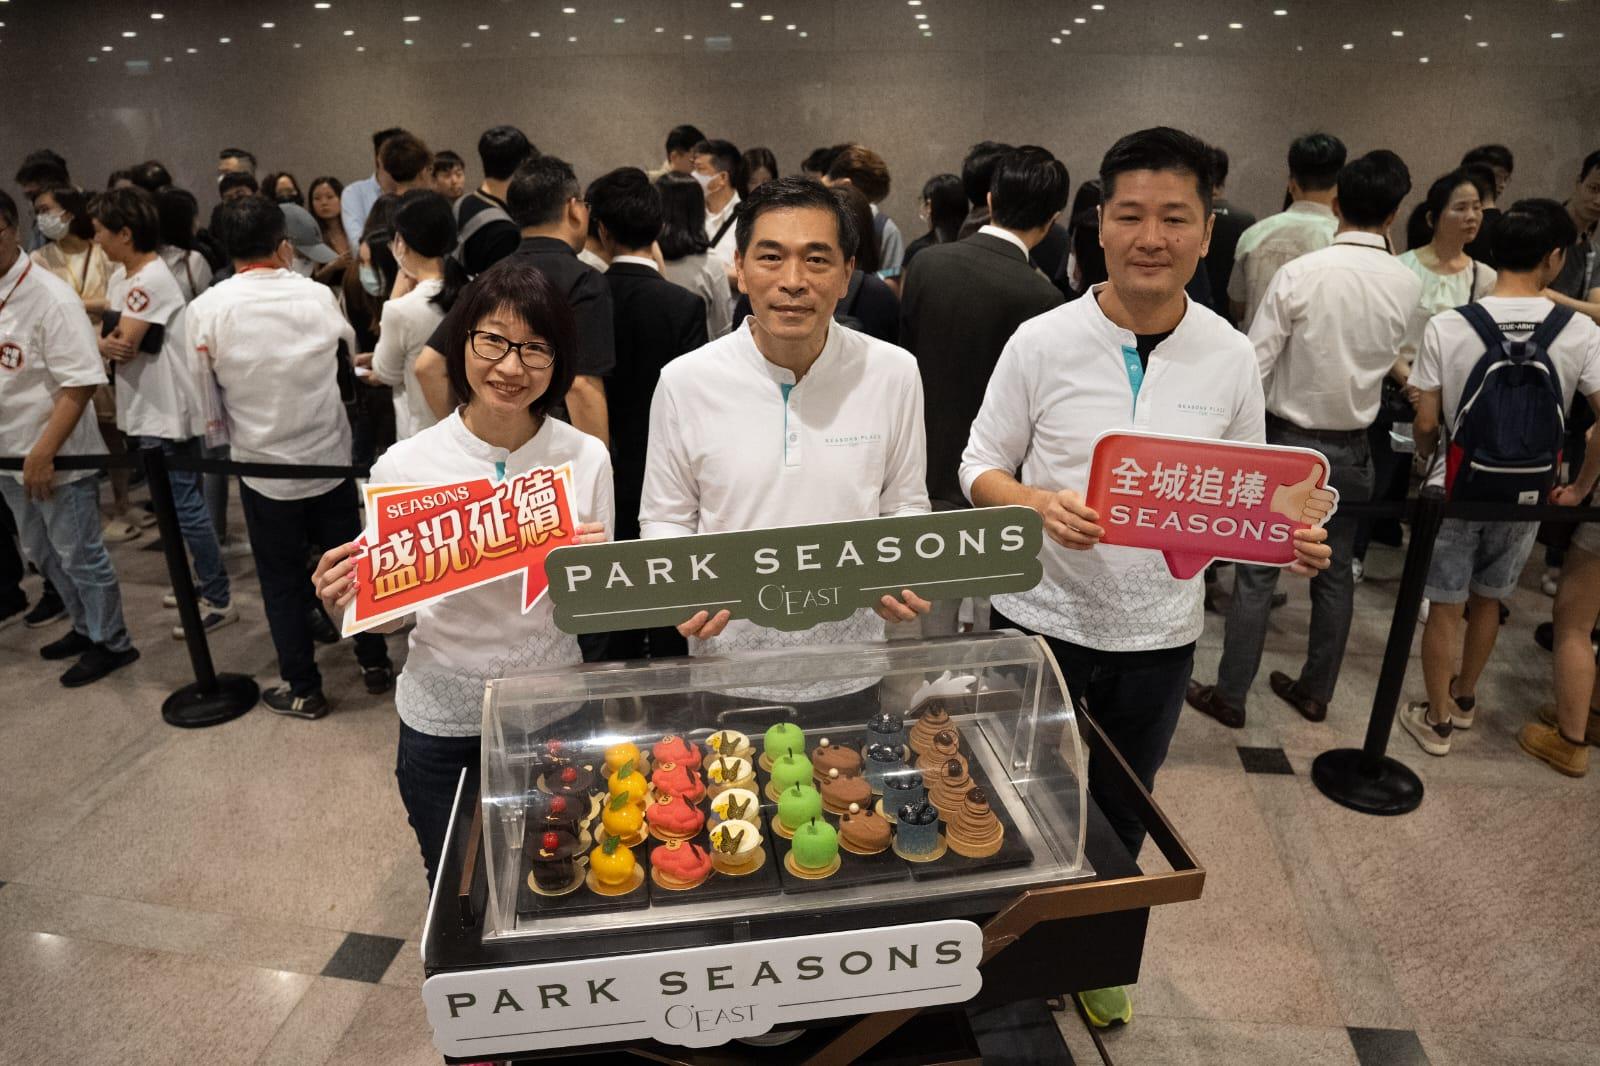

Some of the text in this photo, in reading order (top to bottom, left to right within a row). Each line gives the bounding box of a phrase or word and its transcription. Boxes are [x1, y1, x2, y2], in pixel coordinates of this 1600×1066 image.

[386, 485, 470, 519] SEASONS
[1109, 457, 1268, 510] 全城追捧
[369, 471, 566, 601] 盛況延續
[1108, 505, 1291, 544] SEASONS
[564, 525, 1025, 592] PARK SEASONS
[444, 940, 962, 1018] PARK SEASONS
